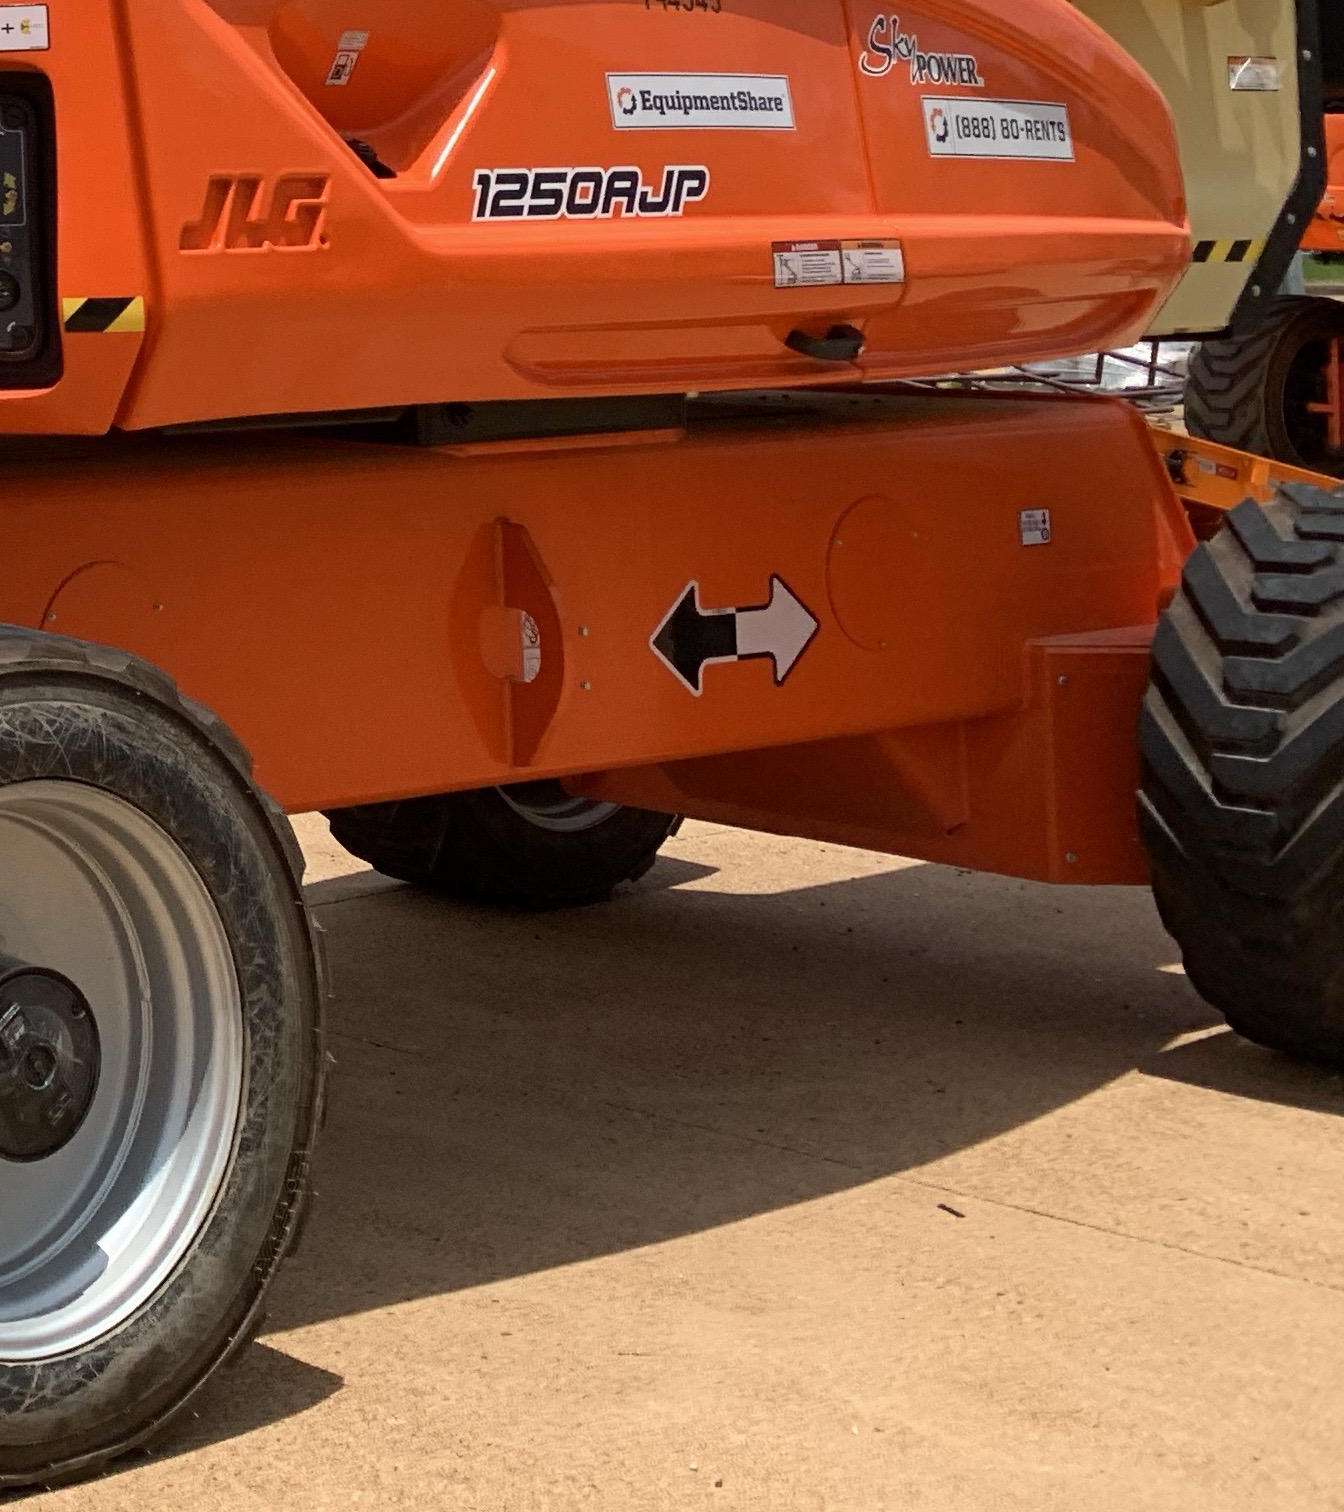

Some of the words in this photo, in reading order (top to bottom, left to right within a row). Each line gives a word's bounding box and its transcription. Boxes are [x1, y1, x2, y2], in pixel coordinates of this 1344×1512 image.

[638, 89, 784, 116] EquipmentShare
[955, 114, 997, 141] (888)
[178, 171, 332, 252] JLG
[473, 166, 710, 221] 1250AJP
